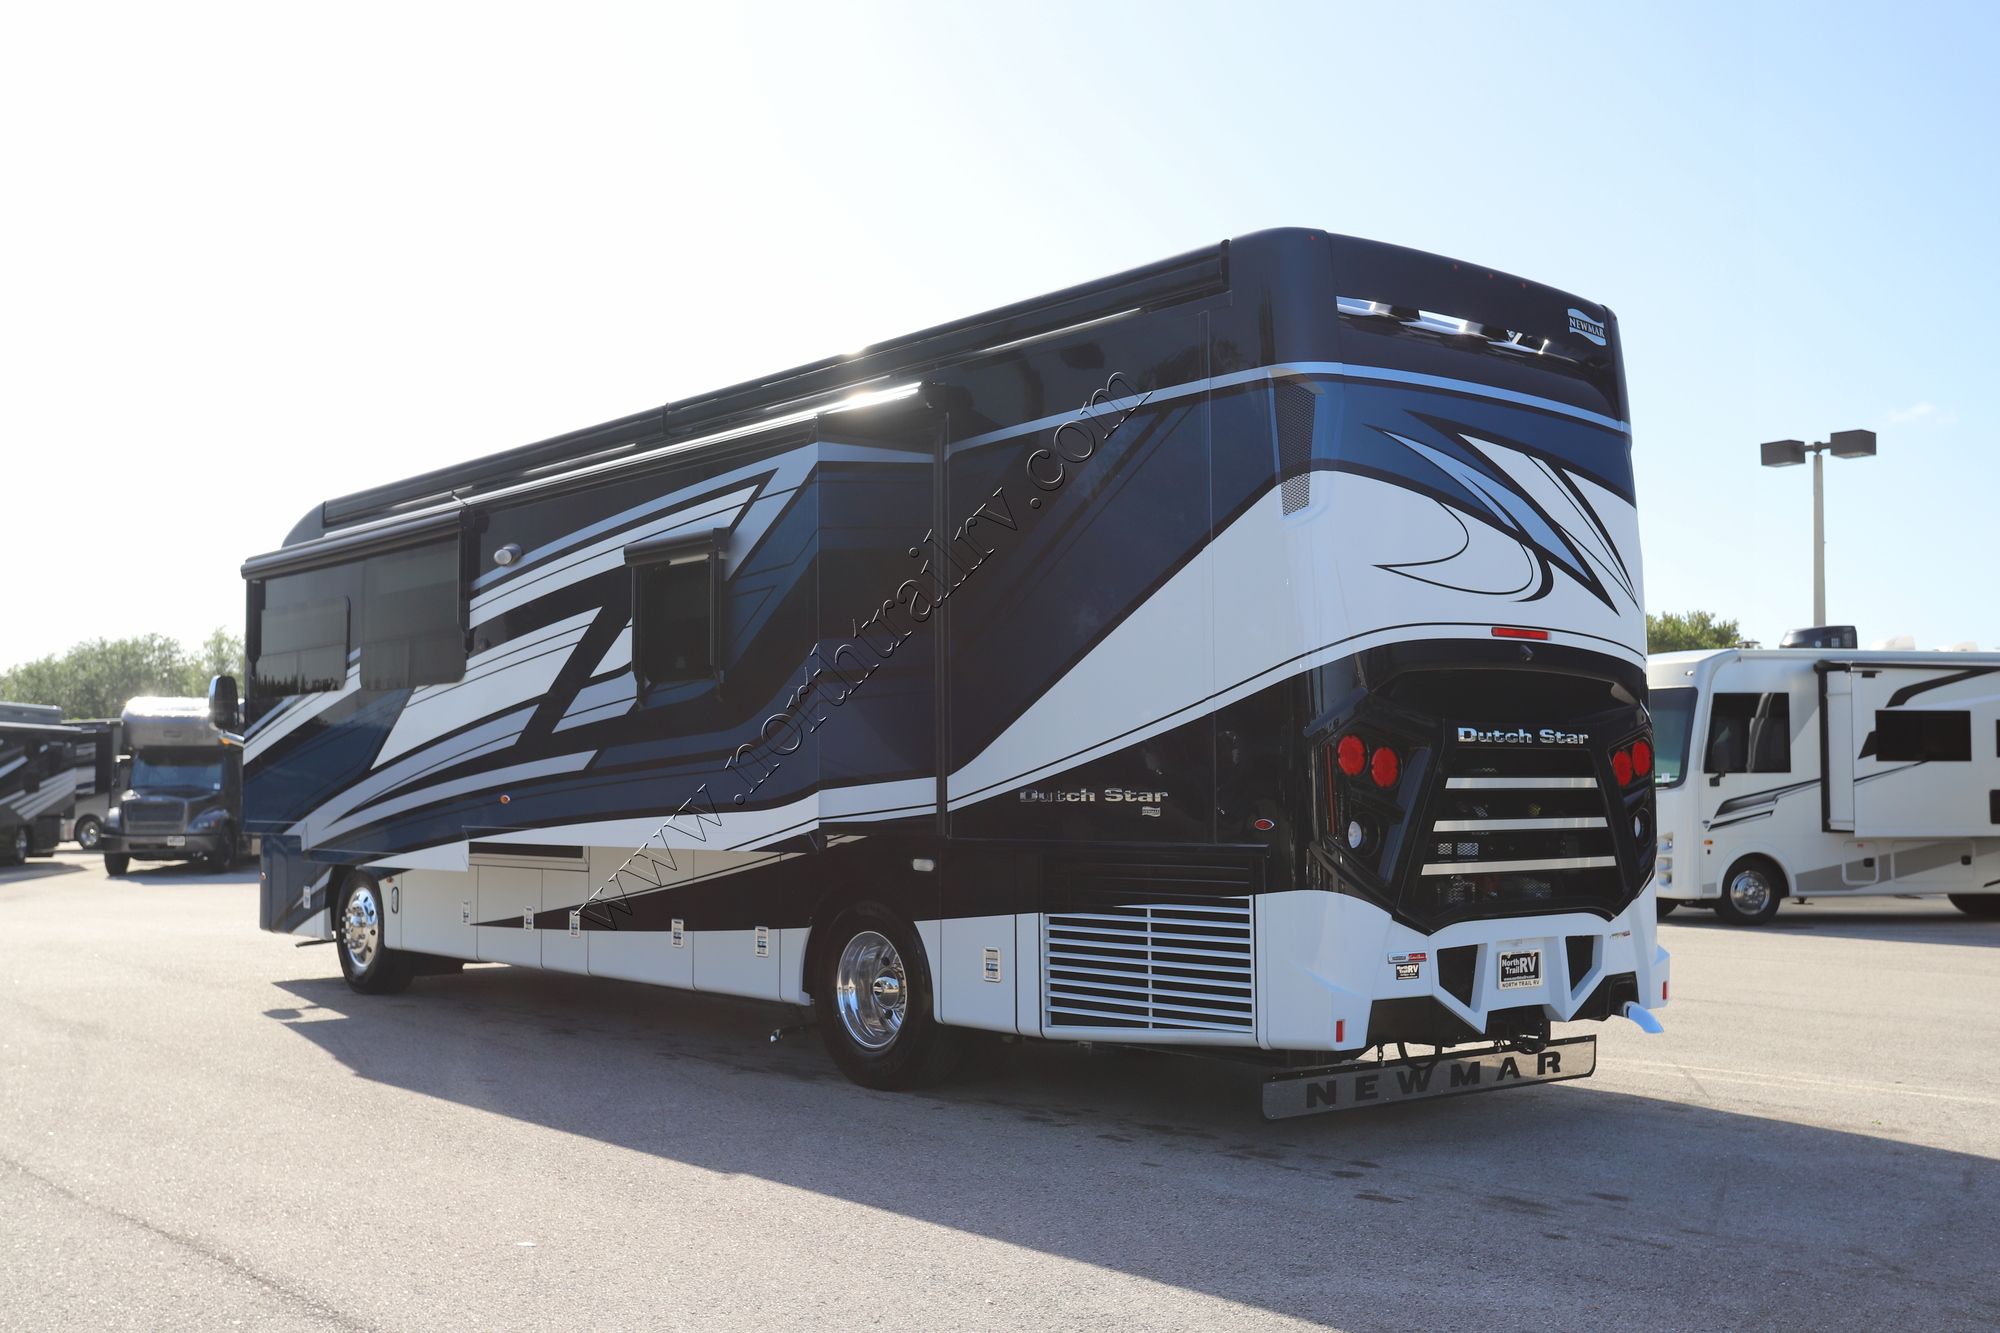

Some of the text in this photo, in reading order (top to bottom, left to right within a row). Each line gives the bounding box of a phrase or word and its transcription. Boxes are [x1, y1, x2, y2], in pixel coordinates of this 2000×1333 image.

[1569, 317, 1605, 338] NEWMAR
[1457, 727, 1589, 745] Dutch Star
[1019, 787, 1169, 803] Dutch Star
[1502, 957, 1536, 973] North RV
[1505, 966, 1520, 975] Trail
[1306, 1051, 1562, 1109] NEWMAR
